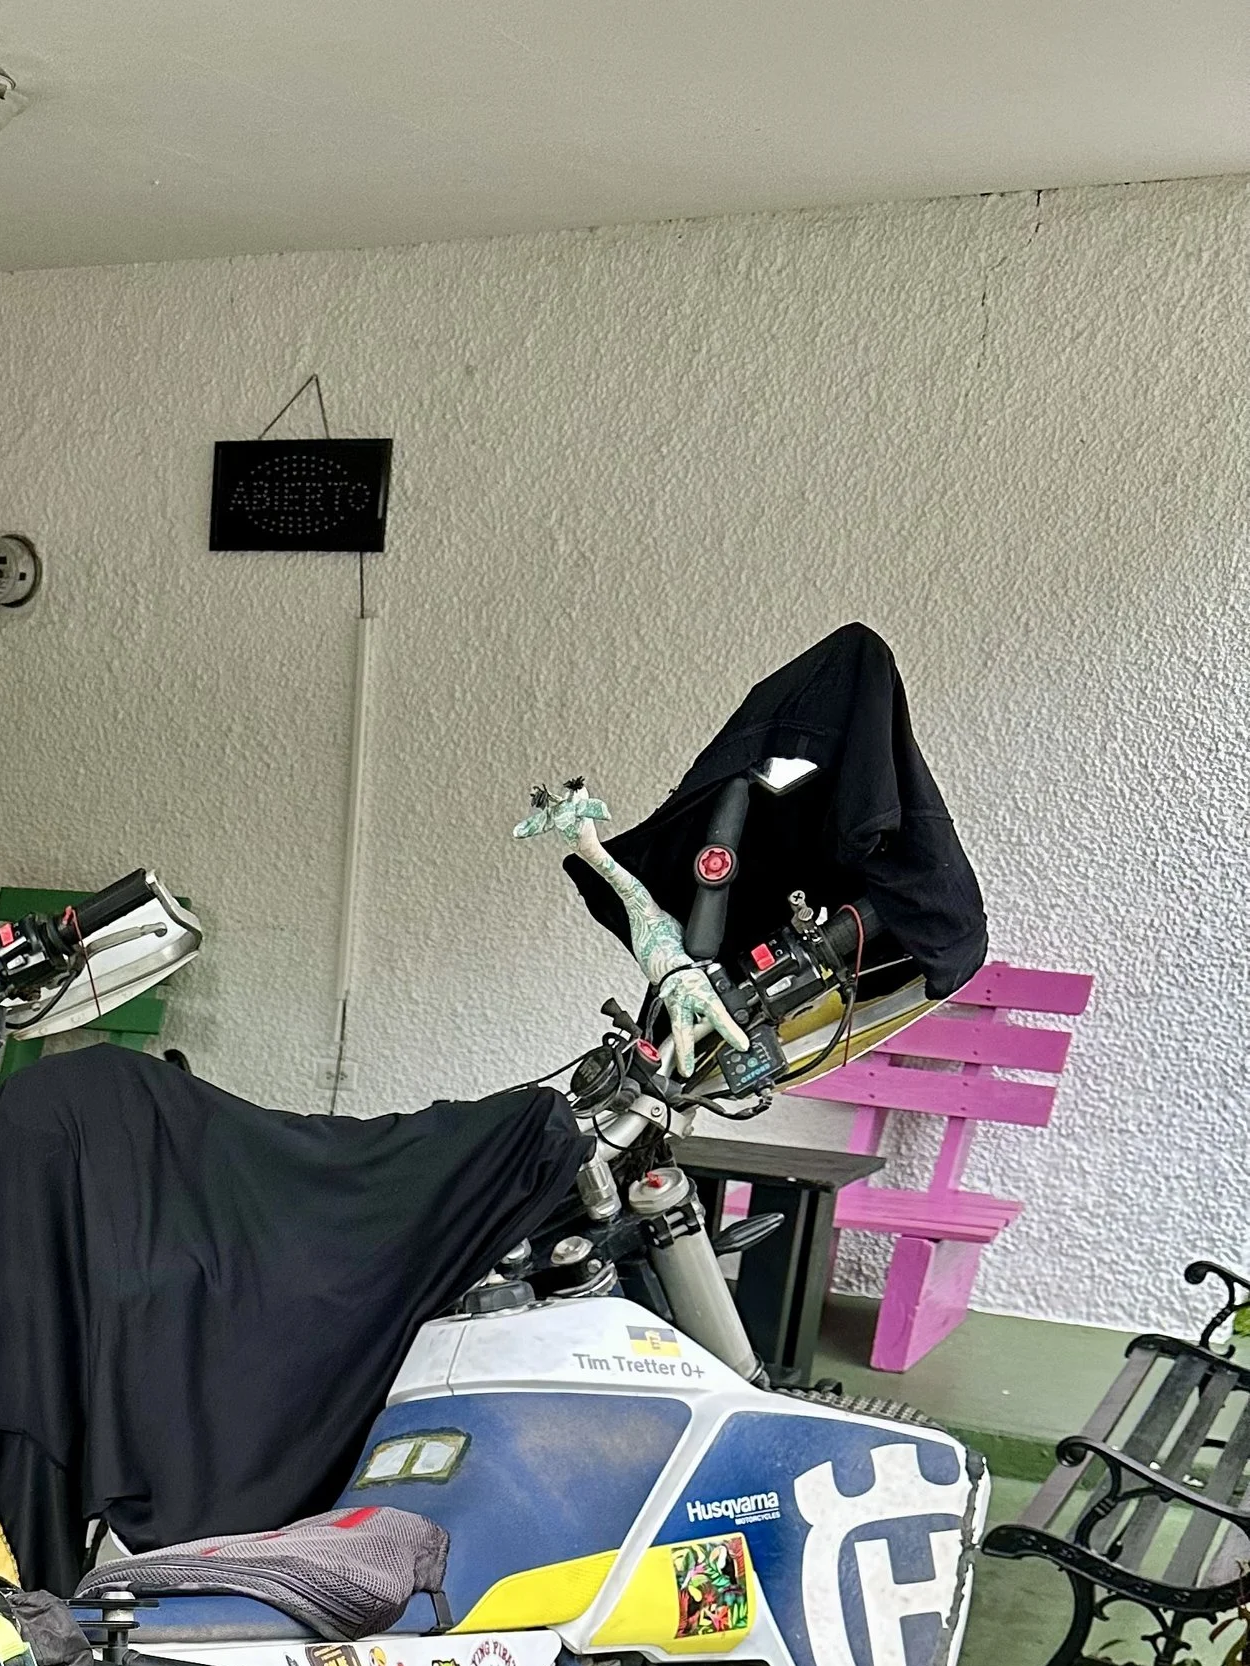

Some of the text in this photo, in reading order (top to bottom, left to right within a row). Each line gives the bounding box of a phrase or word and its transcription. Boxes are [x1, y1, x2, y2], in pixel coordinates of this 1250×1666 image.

[229, 480, 371, 511] ABIERTO
[572, 1353, 611, 1371] Tim
[612, 1355, 676, 1376] Tretter
[686, 1491, 780, 1523] Husqvarna
[734, 1511, 781, 1525] MOTORCYCLES
